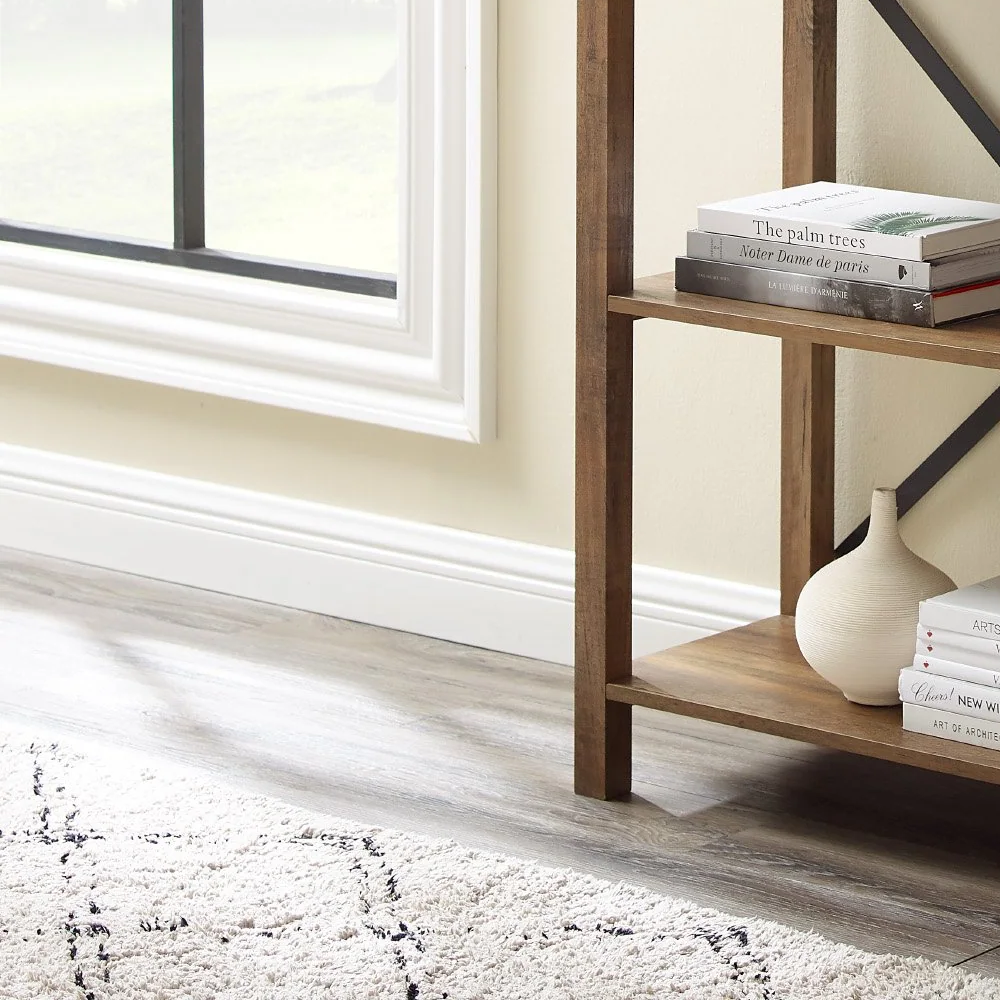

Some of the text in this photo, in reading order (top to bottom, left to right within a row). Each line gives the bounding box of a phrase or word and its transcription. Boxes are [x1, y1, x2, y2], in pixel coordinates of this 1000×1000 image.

[753, 219, 866, 249] The palm trees
[739, 244, 774, 261] Noter
[777, 252, 812, 267] Dame
[816, 257, 831, 269] de
[835, 260, 870, 275] paris
[768, 281, 777, 289] LA
[911, 681, 954, 702] Cheers!
[958, 695, 983, 710] NEW
[933, 719, 949, 730] ART
[952, 723, 963, 733] OF
